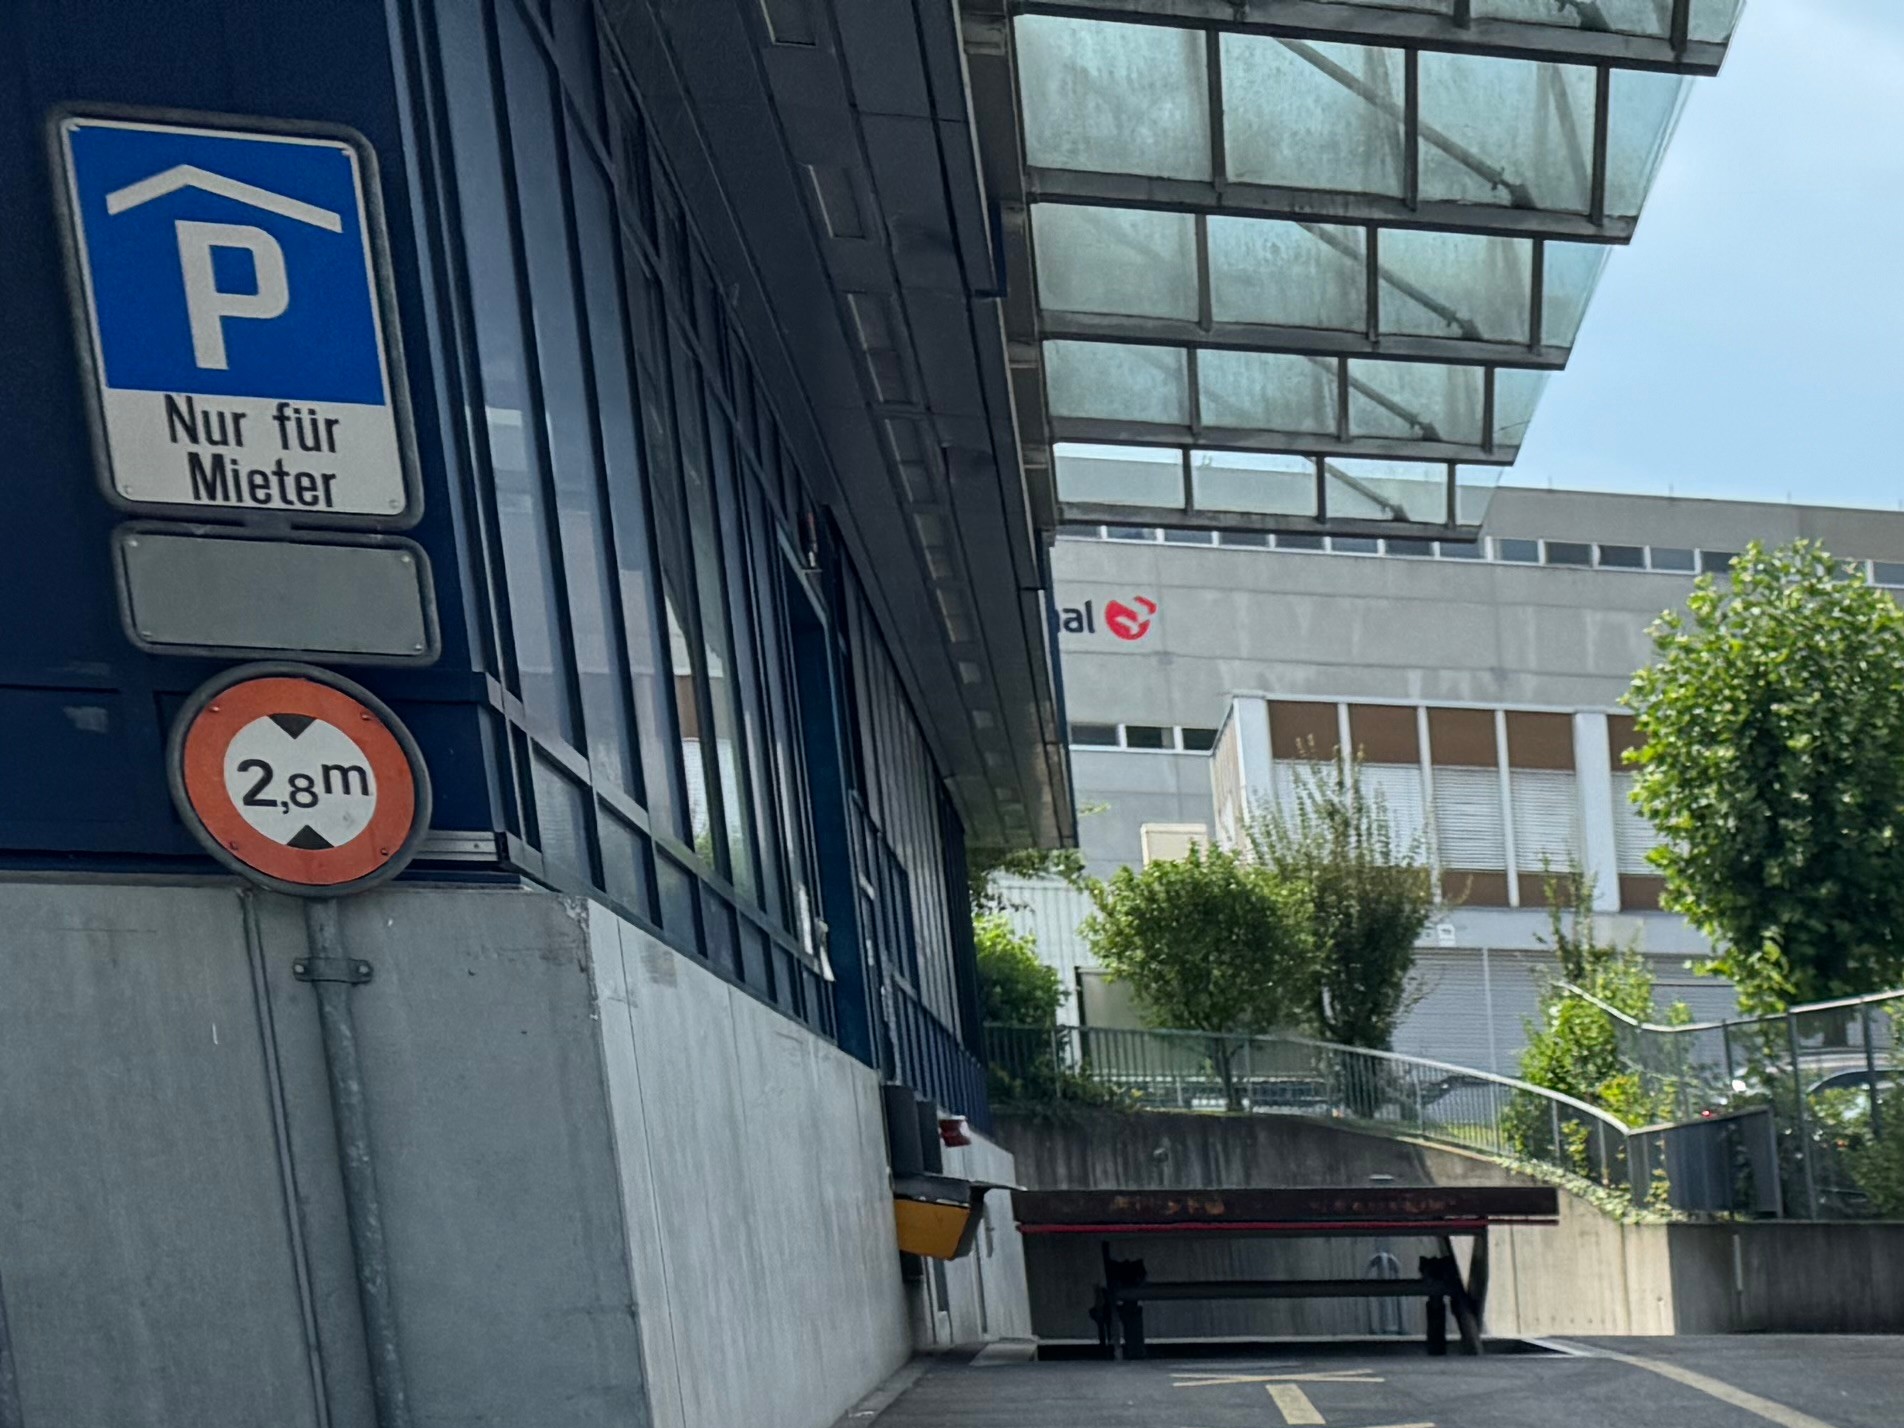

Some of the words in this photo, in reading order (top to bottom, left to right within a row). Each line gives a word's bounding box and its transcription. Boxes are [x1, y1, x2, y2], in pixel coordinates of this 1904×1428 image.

[175, 219, 289, 370] P
[164, 393, 247, 448] Nur
[272, 402, 340, 454] für
[187, 451, 337, 508] Mieter
[1057, 599, 1096, 634] al
